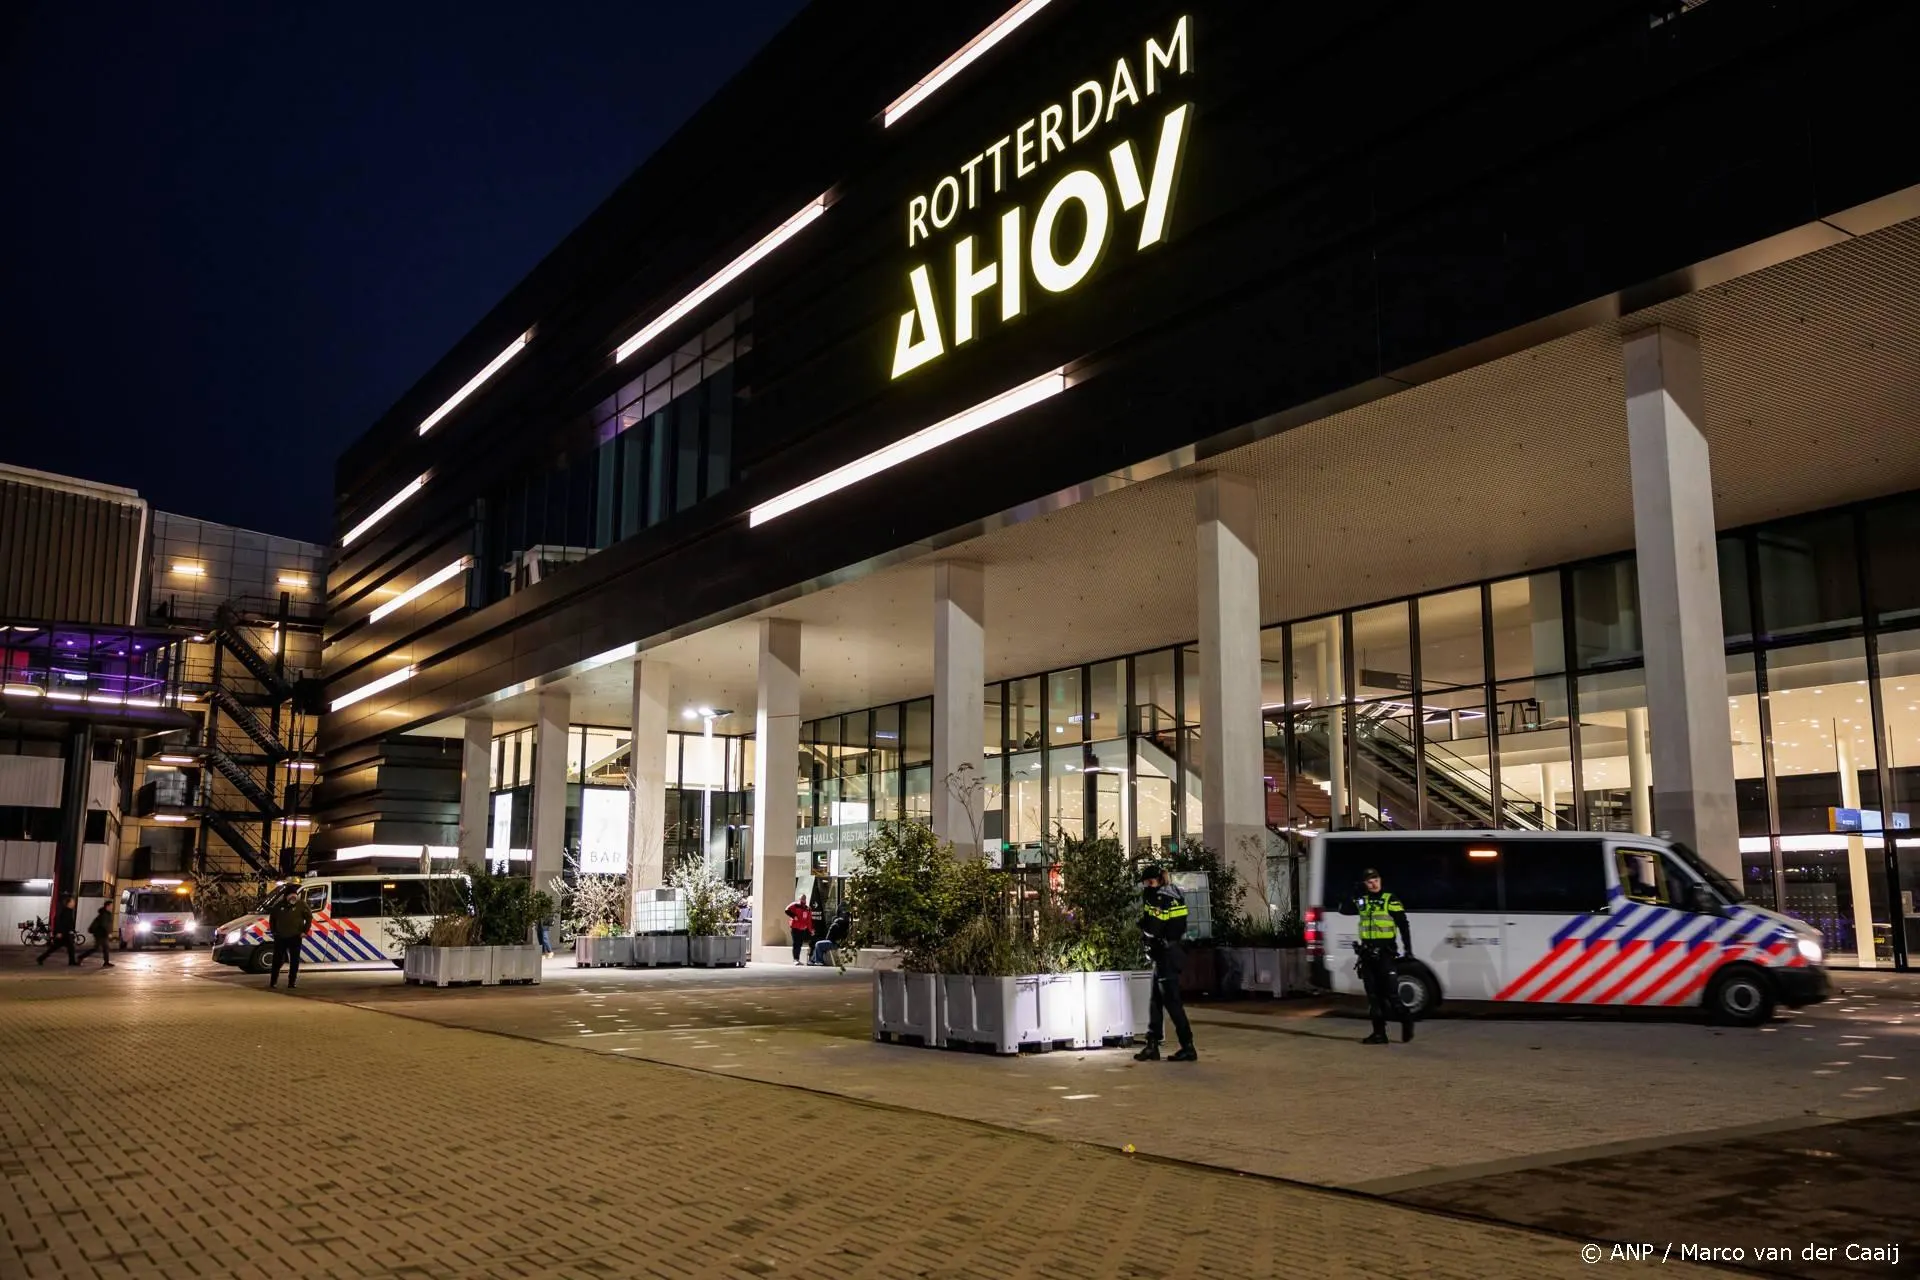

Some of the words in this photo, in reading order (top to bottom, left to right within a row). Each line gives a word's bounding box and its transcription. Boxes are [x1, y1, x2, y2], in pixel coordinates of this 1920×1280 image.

[909, 15, 1188, 248] ROTTERDAM
[890, 103, 1189, 380] AHOY
[590, 851, 621, 863] BAR
[796, 835, 811, 845] VENT
[814, 832, 834, 843] HALLS
